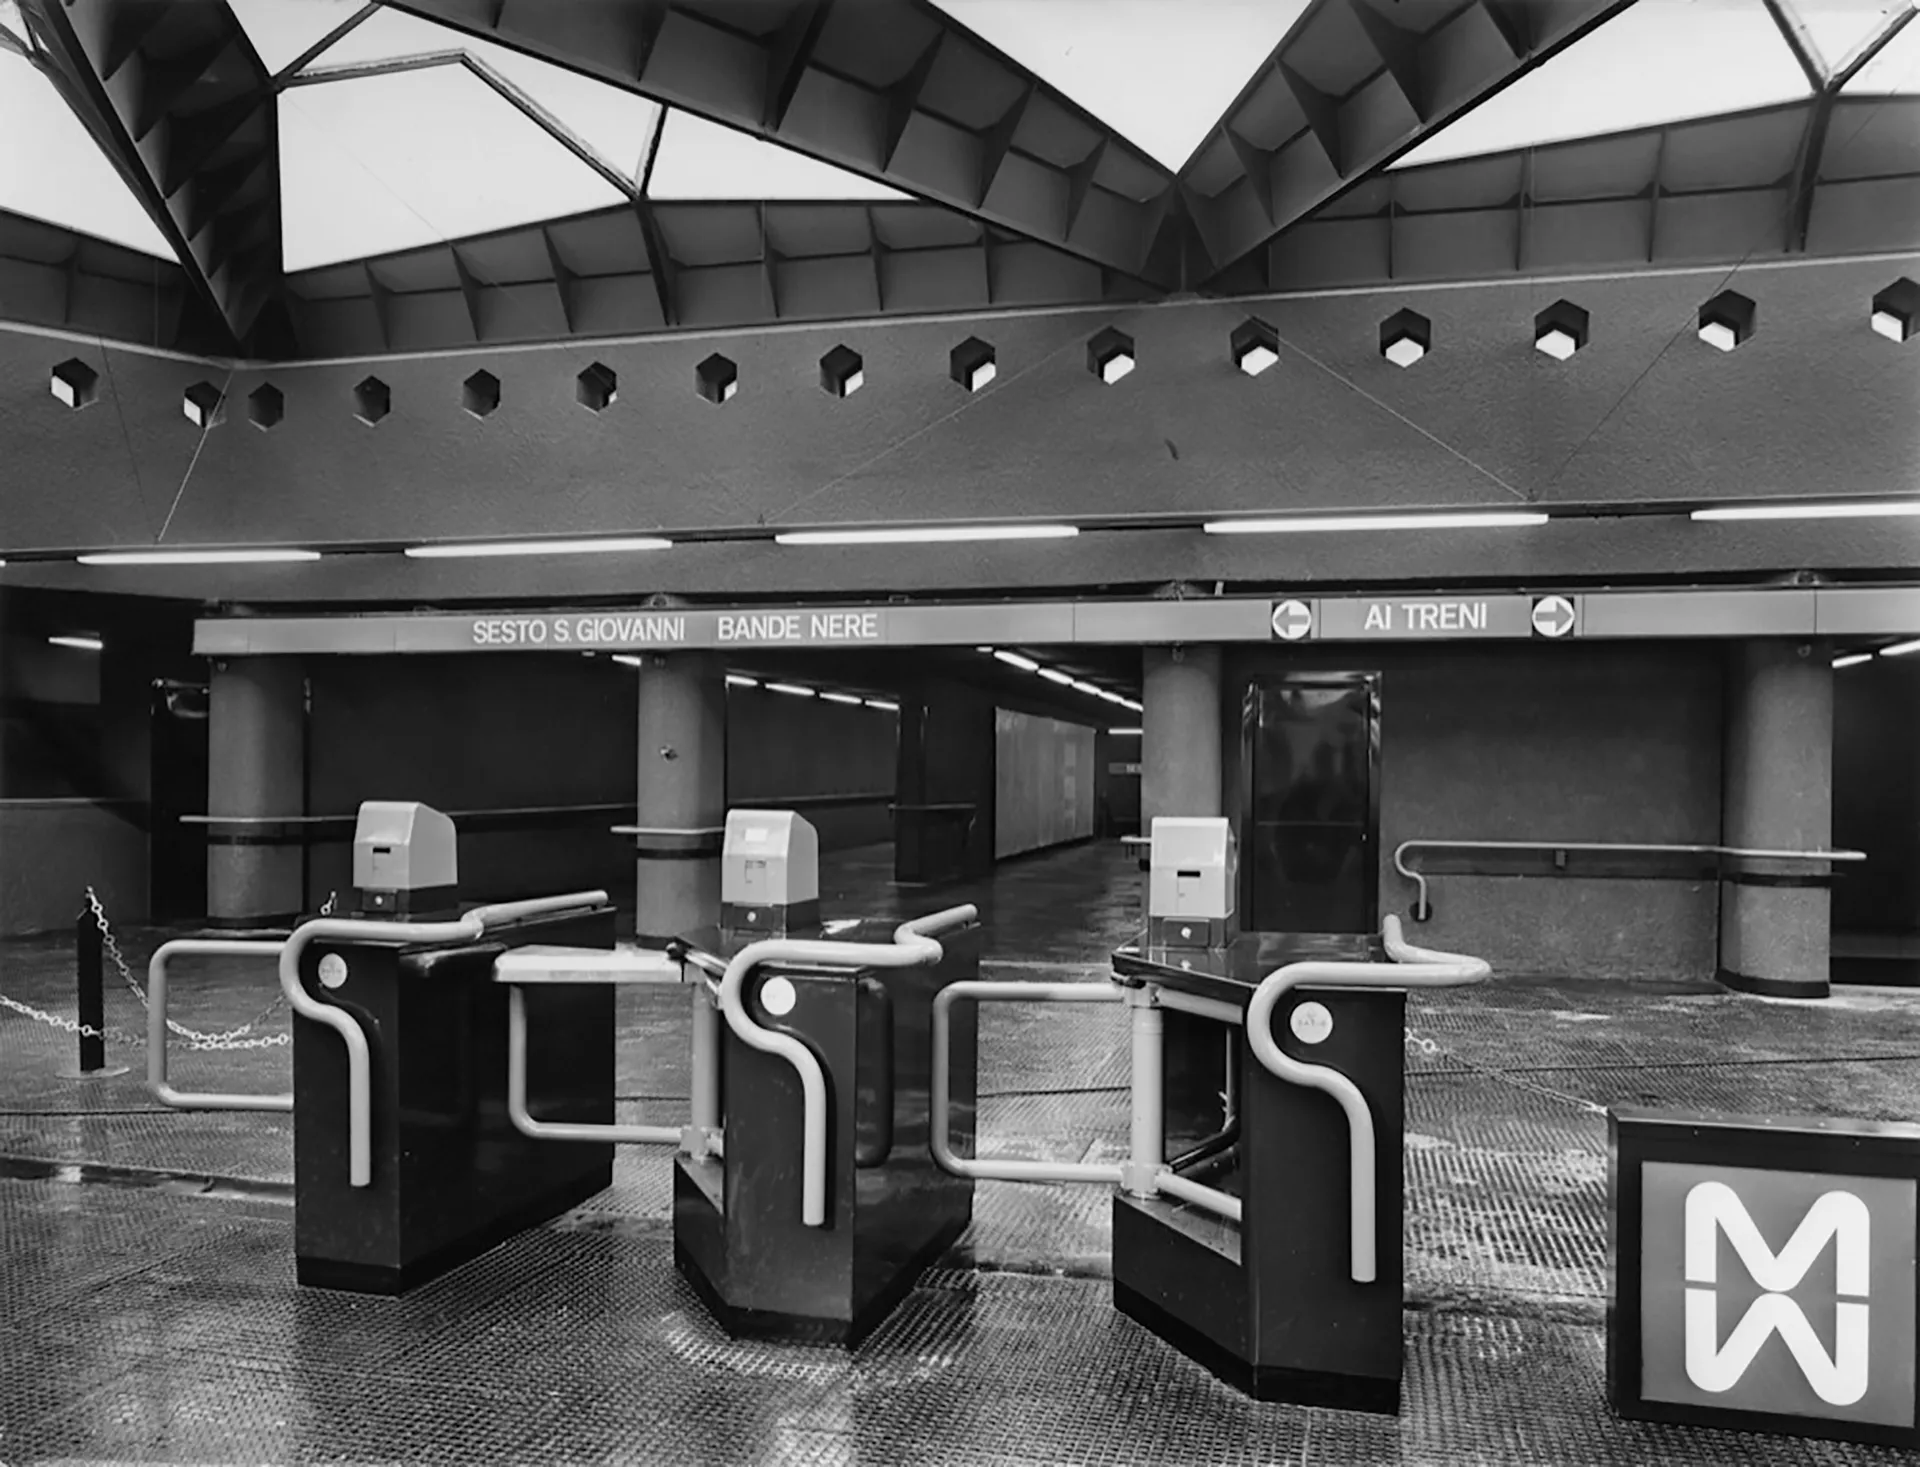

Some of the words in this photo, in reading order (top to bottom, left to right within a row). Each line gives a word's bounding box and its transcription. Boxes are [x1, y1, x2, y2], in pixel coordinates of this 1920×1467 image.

[718, 615, 801, 641] BANDE
[811, 613, 878, 639] NERE
[1364, 603, 1392, 630] AI
[1401, 602, 1487, 630] TRENI
[473, 619, 547, 644] SESTO
[553, 618, 572, 643] S.
[576, 617, 685, 642] GIOVANNI
